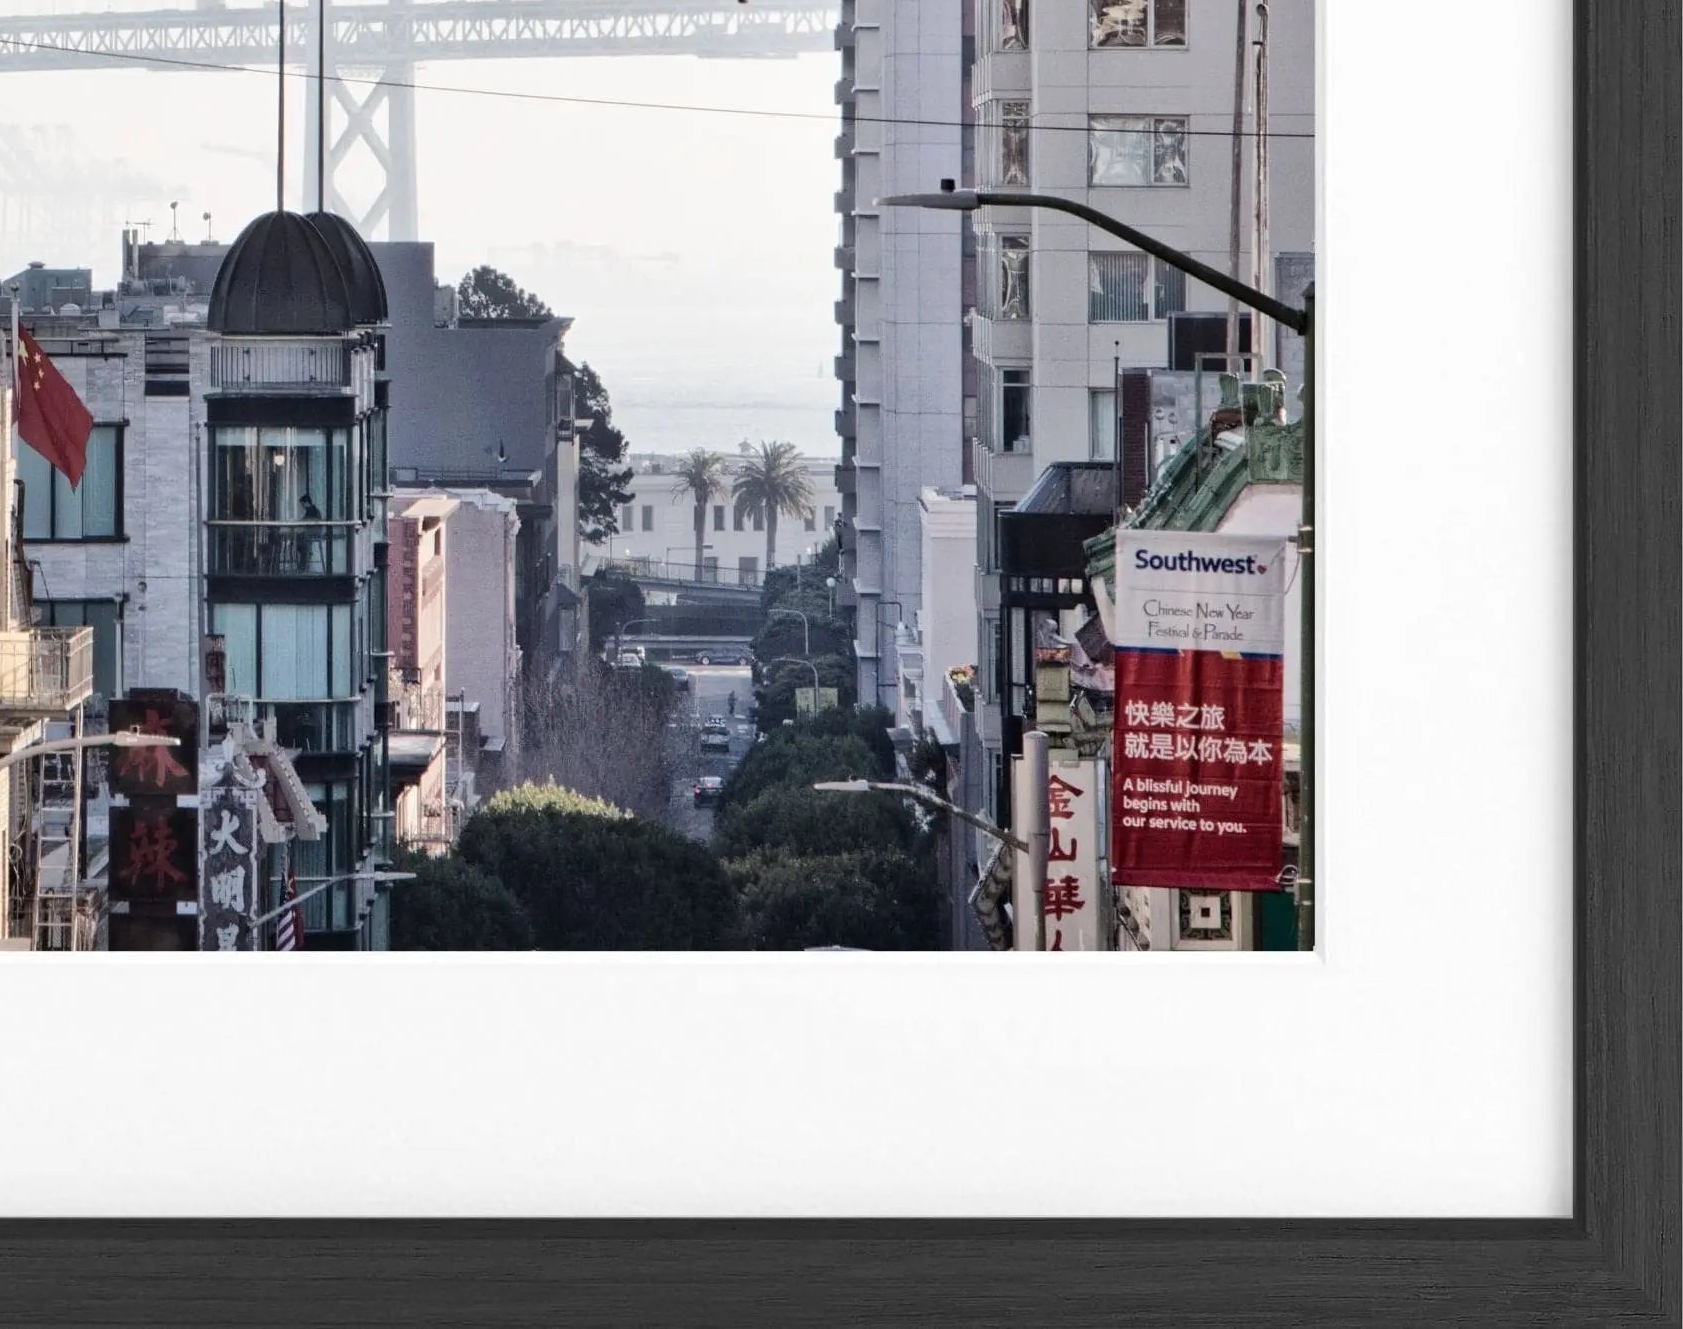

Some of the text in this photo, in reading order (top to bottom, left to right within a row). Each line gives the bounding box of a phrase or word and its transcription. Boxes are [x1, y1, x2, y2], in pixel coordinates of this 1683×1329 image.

[1135, 549, 1256, 575] Southwest
[1143, 599, 1255, 621] Chinese New Year
[1148, 621, 1244, 641] Festival & Parade
[1125, 700, 1225, 731] 快樂之旅
[1125, 733, 1273, 766] 就是以你為本
[1123, 778, 1238, 800] A blissful journey
[1123, 796, 1201, 813] begins with
[1122, 817, 1248, 835] our service to you.
